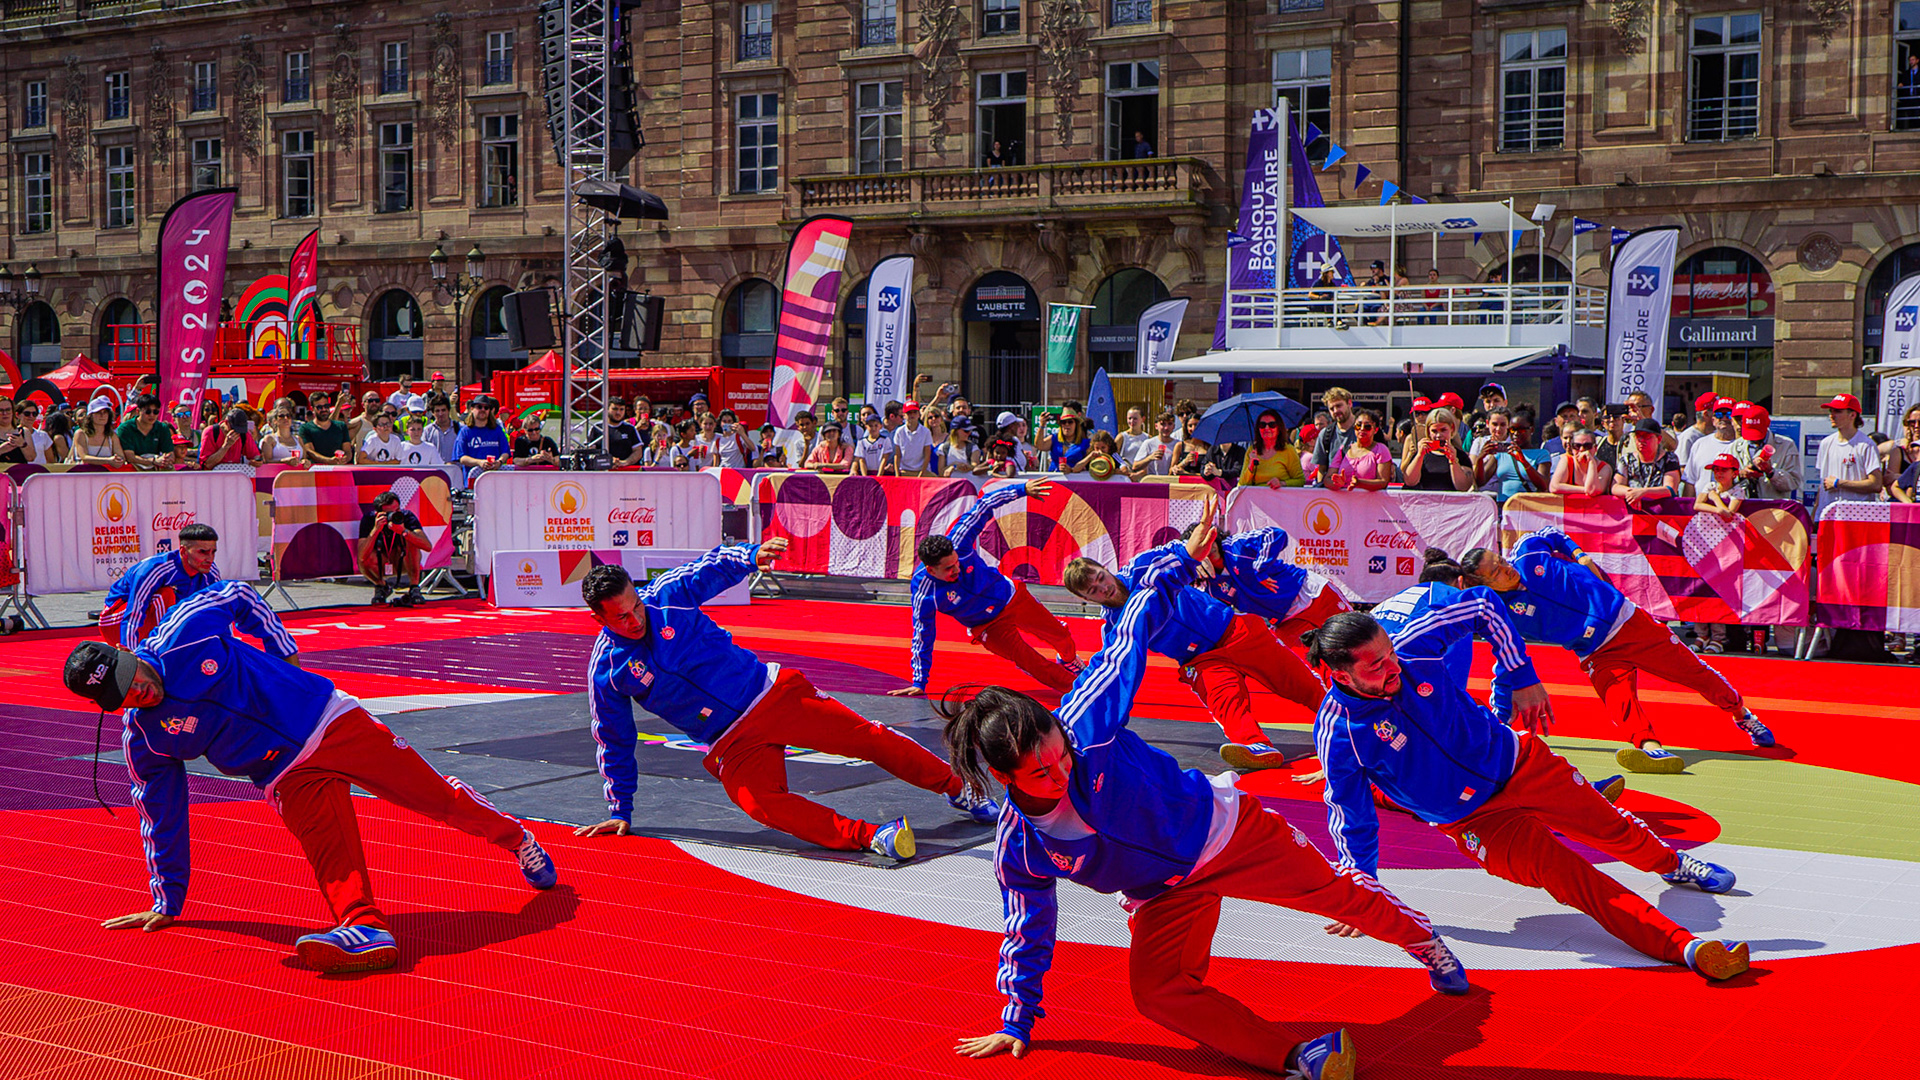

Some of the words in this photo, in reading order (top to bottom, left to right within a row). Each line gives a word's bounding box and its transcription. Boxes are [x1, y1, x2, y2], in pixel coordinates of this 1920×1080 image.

[1262, 149, 1277, 270] POPULAIRE
[1248, 181, 1264, 270] BANQUE
[182, 229, 210, 329] 2024
[977, 303, 1026, 311] L'AUBETTE
[1050, 335, 1073, 343] SORTIE
[1680, 325, 1757, 342] Gallimard
[883, 323, 894, 395] POPULAIRE
[1620, 331, 1635, 396] BANQUE
[874, 341, 884, 395] BANQUE
[608, 507, 656, 524] Coca-Cola
[95, 526, 123, 536] RELAIS
[126, 525, 136, 534] DE
[92, 537, 102, 545] LA
[104, 535, 140, 544] FLAMME
[544, 534, 595, 542] OLYMPIQUE
[1299, 538, 1331, 547] RELAIS
[1363, 529, 1419, 549] Coca-Cola
[92, 545, 140, 555] OLYMPIQUE
[1295, 547, 1306, 555] LA
[1308, 548, 1349, 557] FLAMME
[1294, 557, 1349, 566] OLYMPIQUE
